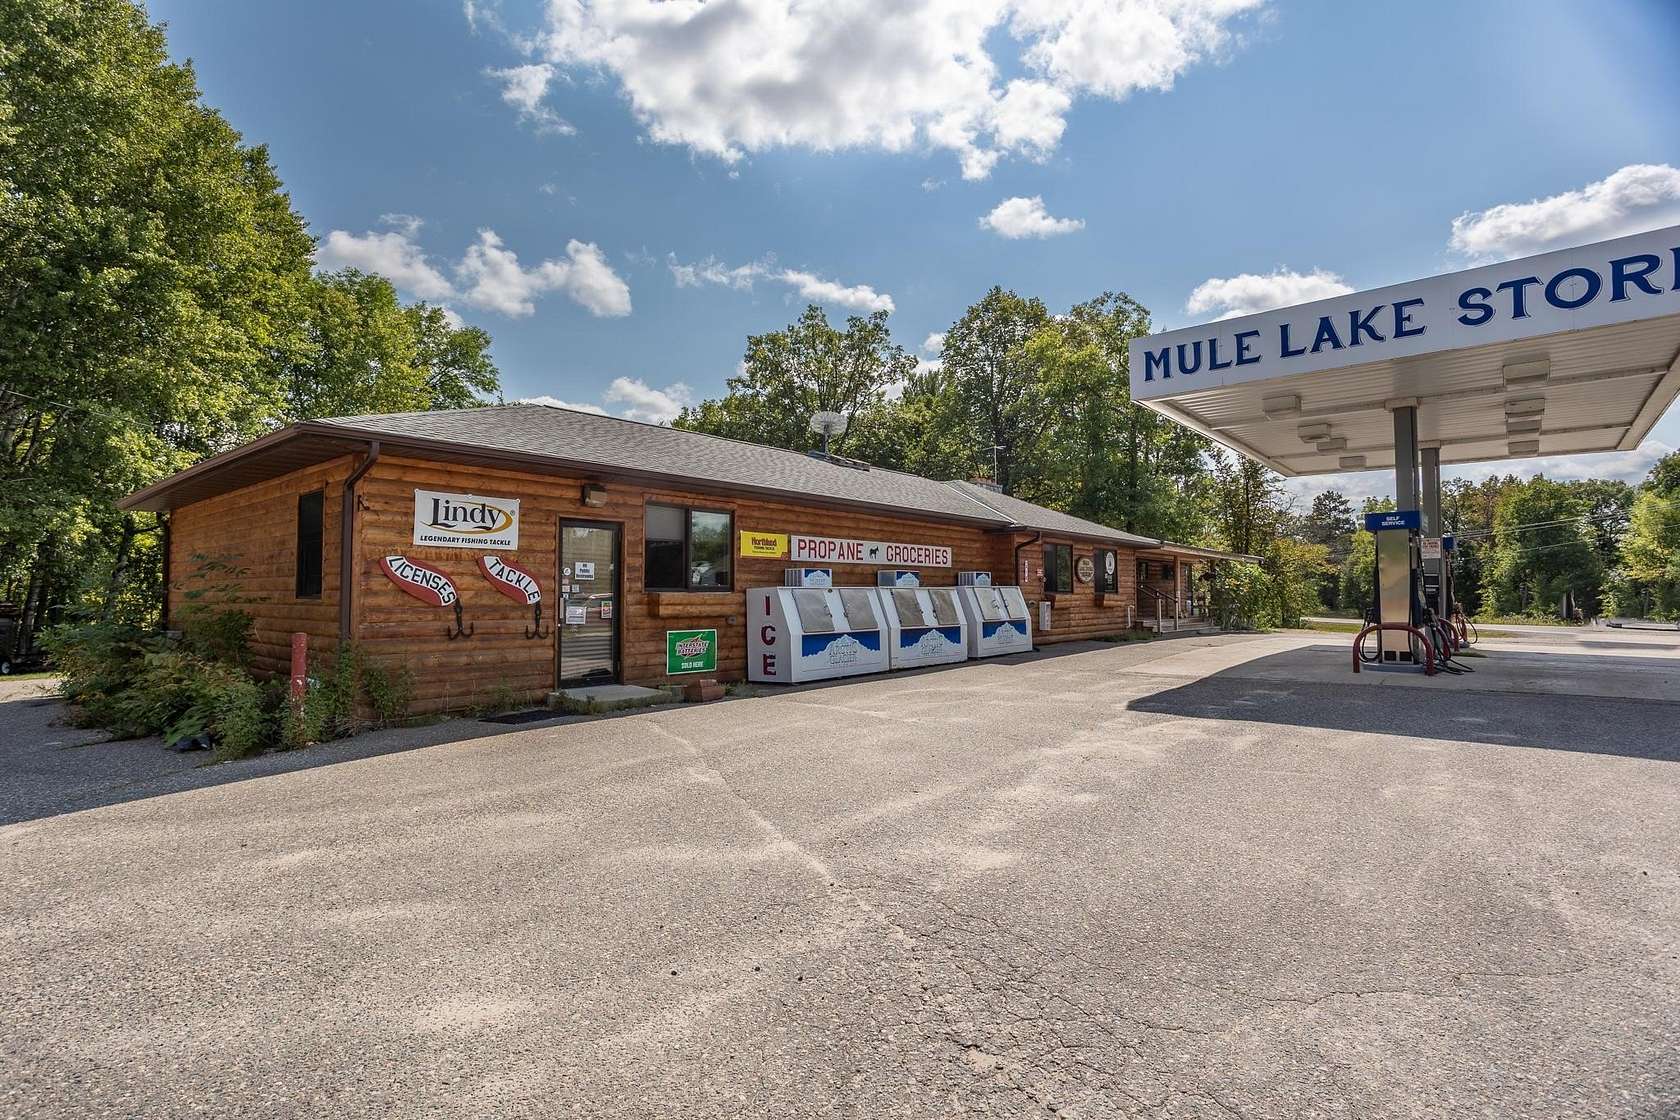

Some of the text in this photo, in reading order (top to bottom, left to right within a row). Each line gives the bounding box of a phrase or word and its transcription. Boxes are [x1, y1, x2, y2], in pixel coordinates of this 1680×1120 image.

[1144, 329, 1262, 382] MULE
[1279, 297, 1427, 359] LAKE
[424, 497, 503, 531] Lindy
[420, 535, 511, 546] LEGENDARY FISHING TACKLE
[796, 538, 949, 565] PROPANE GROCERIES
[388, 556, 456, 603] LICENSES
[488, 558, 540, 602] TACKLE
[760, 595, 777, 676] ICE
